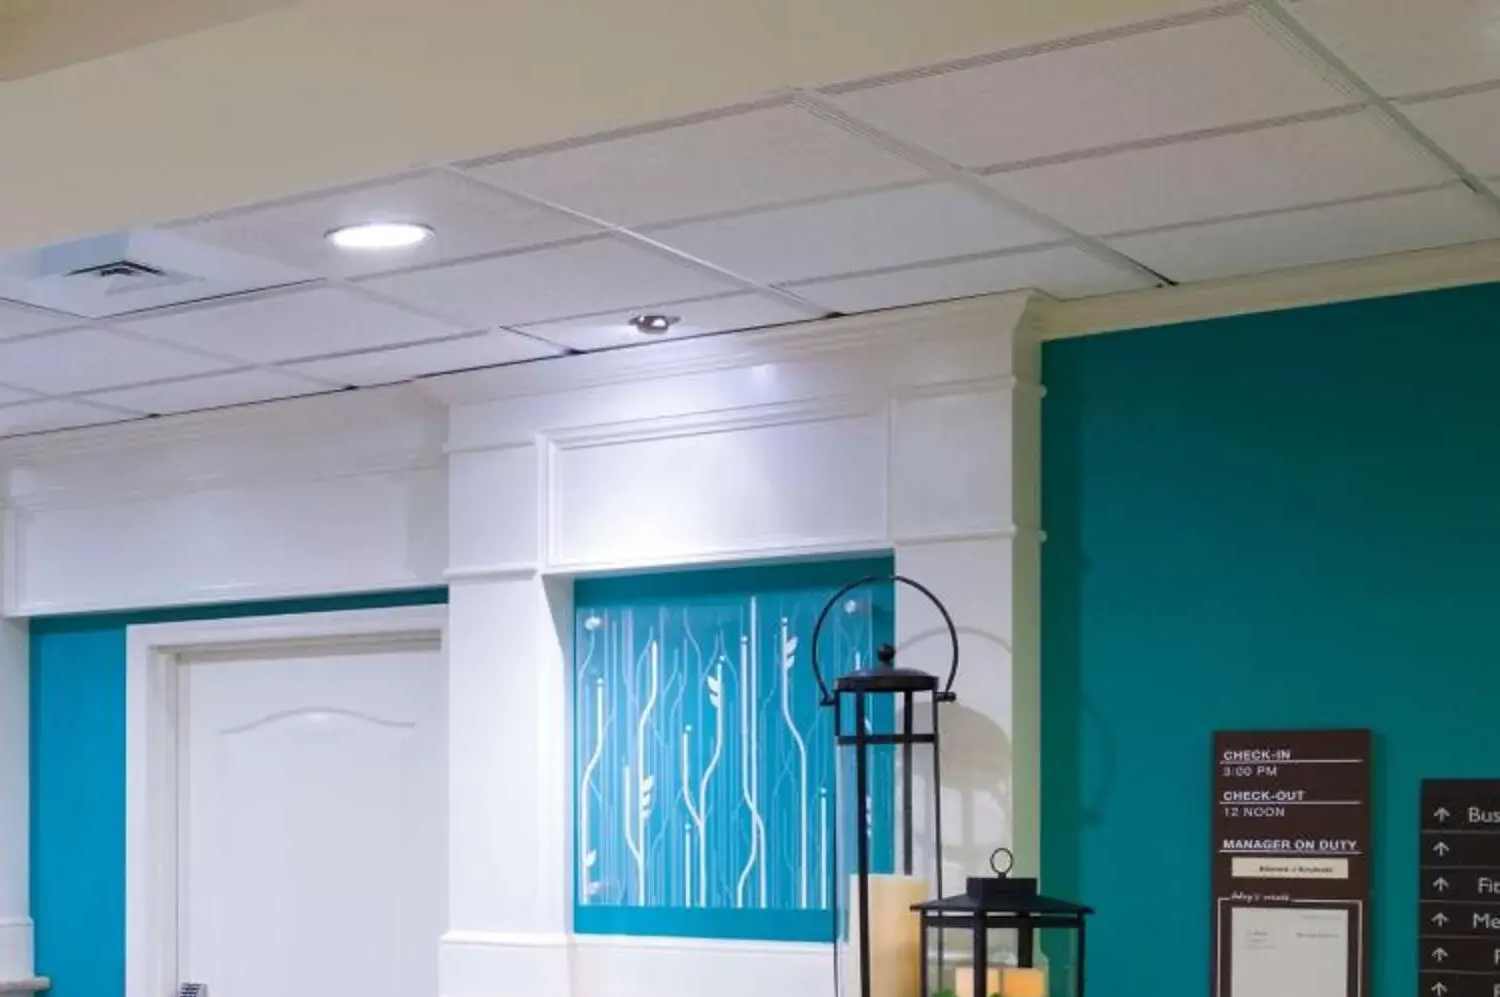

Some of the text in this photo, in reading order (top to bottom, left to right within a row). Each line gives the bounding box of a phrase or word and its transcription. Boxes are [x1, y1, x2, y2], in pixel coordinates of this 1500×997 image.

[1223, 749, 1291, 761] CHECK-IN
[1257, 766, 1278, 777] PM
[1223, 790, 1306, 801] CHECK-OUT
[1224, 807, 1285, 817] 12 NOON
[1223, 839, 1357, 850] MANAGER ON DUTY
